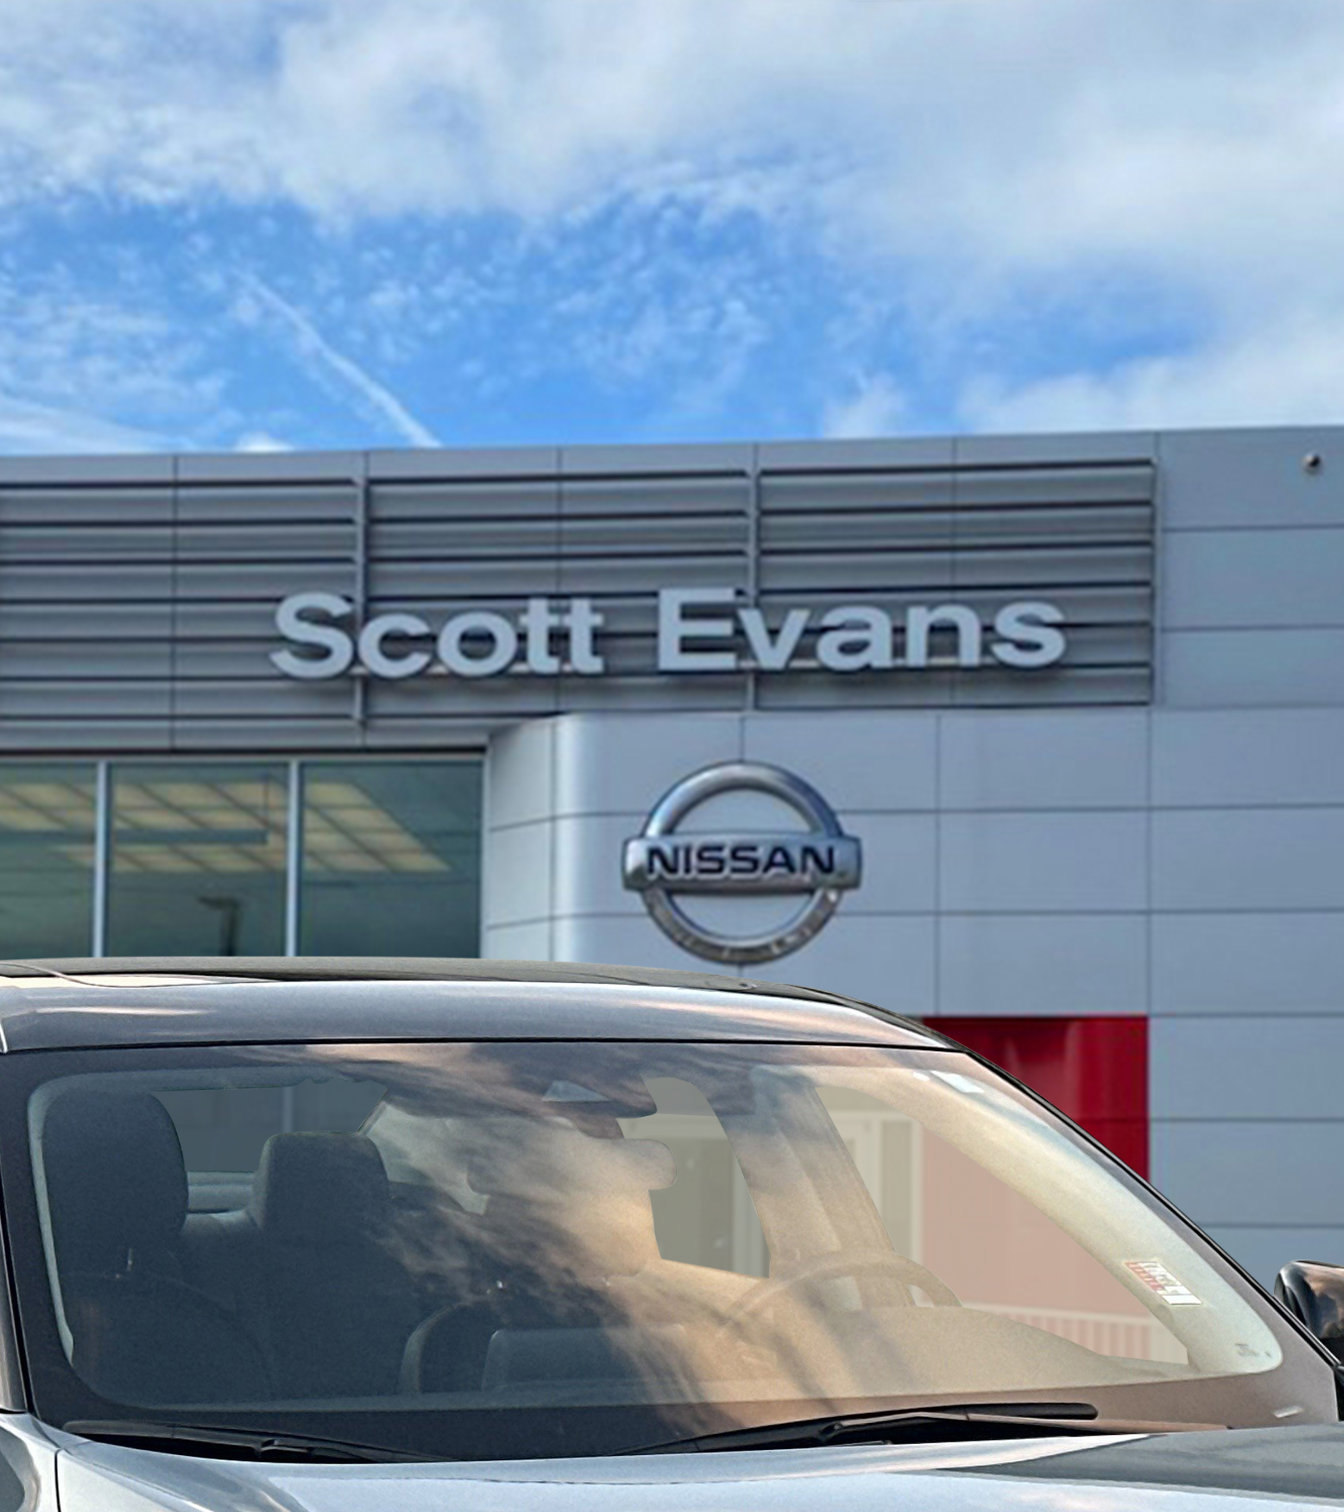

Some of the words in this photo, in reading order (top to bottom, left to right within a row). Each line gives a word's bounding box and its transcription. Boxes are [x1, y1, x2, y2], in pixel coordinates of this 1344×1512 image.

[270, 591, 604, 679] Scott
[657, 587, 1067, 673] Evans
[645, 843, 837, 879] NISSAN
